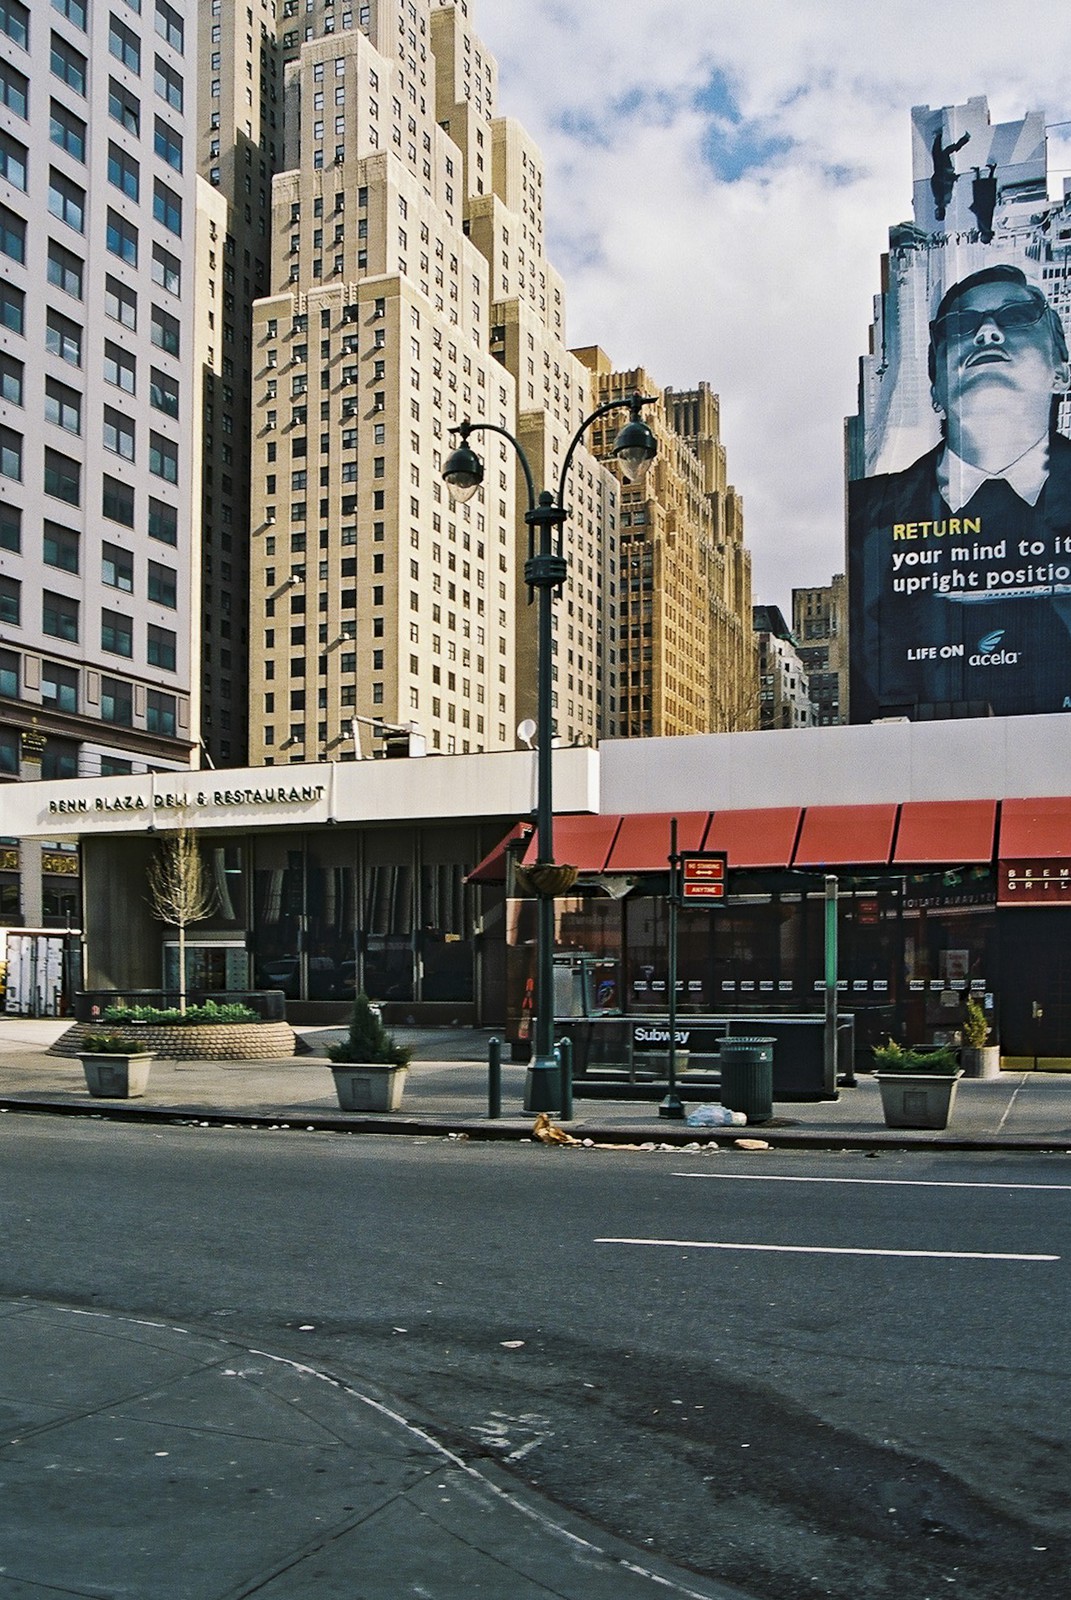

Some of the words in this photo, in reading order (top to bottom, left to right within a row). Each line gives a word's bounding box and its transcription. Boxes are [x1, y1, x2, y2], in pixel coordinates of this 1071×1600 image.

[893, 517, 982, 541] RETURN
[892, 549, 942, 571] your
[951, 540, 1006, 562] mind
[1018, 539, 1045, 557] to
[893, 568, 979, 595] upright
[986, 563, 1070, 589] positio
[907, 647, 937, 661] LIFE
[940, 644, 965, 658] ON
[968, 649, 1019, 667] acela
[49, 798, 87, 813] PENN
[95, 795, 145, 810] PLAZA
[154, 793, 187, 808] DELI
[197, 791, 206, 805] &
[213, 785, 325, 805] RESTAURANT
[634, 1027, 690, 1044] Subway
